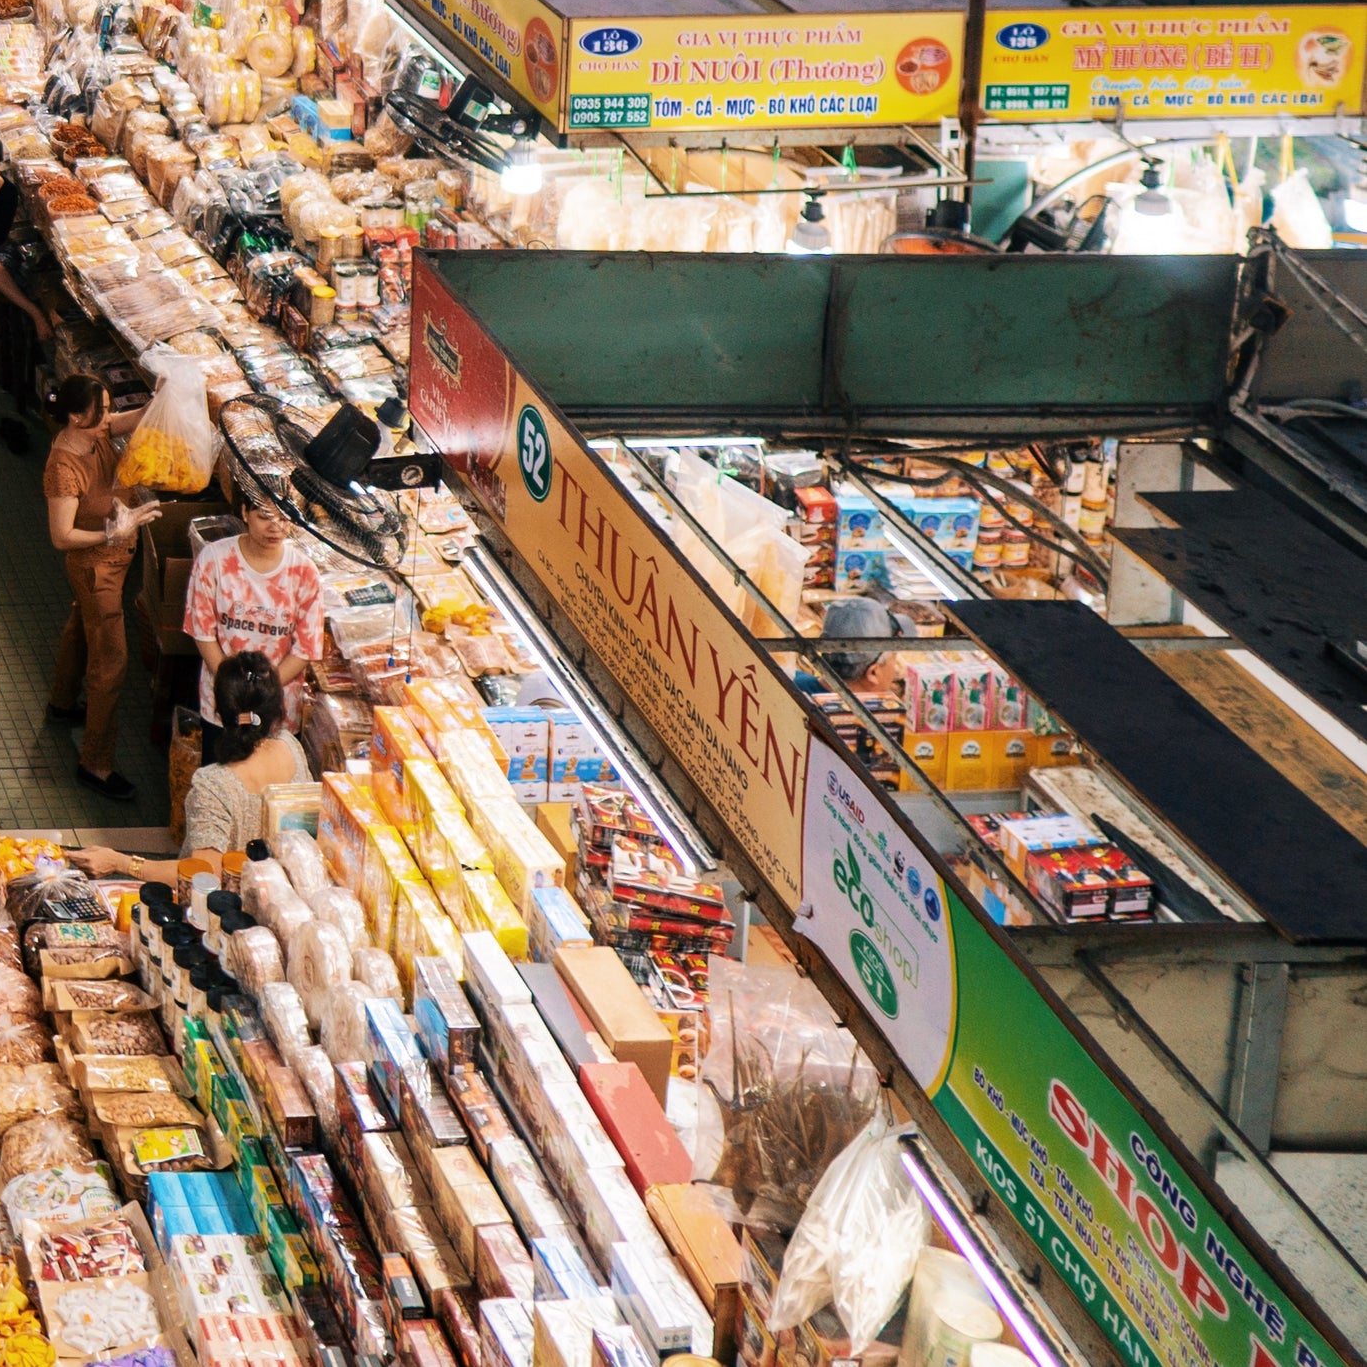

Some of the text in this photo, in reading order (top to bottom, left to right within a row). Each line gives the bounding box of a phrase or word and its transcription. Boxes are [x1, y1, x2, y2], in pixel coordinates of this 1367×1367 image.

[592, 40, 629, 53] 136
[602, 28, 620, 41] LÔ
[678, 22, 862, 50] GIA VỊ THỰC PHẨM
[650, 53, 886, 84] DÌ NUÔI (Thương)
[1073, 41, 1106, 70] MỸ
[574, 96, 648, 110] 0935 944 309
[574, 110, 648, 123] 0905 787 552
[655, 94, 878, 118] TÔM CÁ MỰC BÒ KHÔ CÁC LOẠI
[521, 414, 547, 488] 52
[220, 611, 255, 633] Space
[553, 457, 804, 816] THUẬN YẾN
[836, 784, 865, 824] USAID
[834, 856, 874, 930] eco
[863, 942, 884, 978] KIOS
[873, 917, 915, 986] shop
[861, 962, 884, 1003] 51
[1048, 1079, 1230, 1323] SHOP
[975, 1138, 1149, 1367] KIOS 51 CHỢ HÀN
[1131, 1134, 1285, 1342] CÔNG NGHỆ
